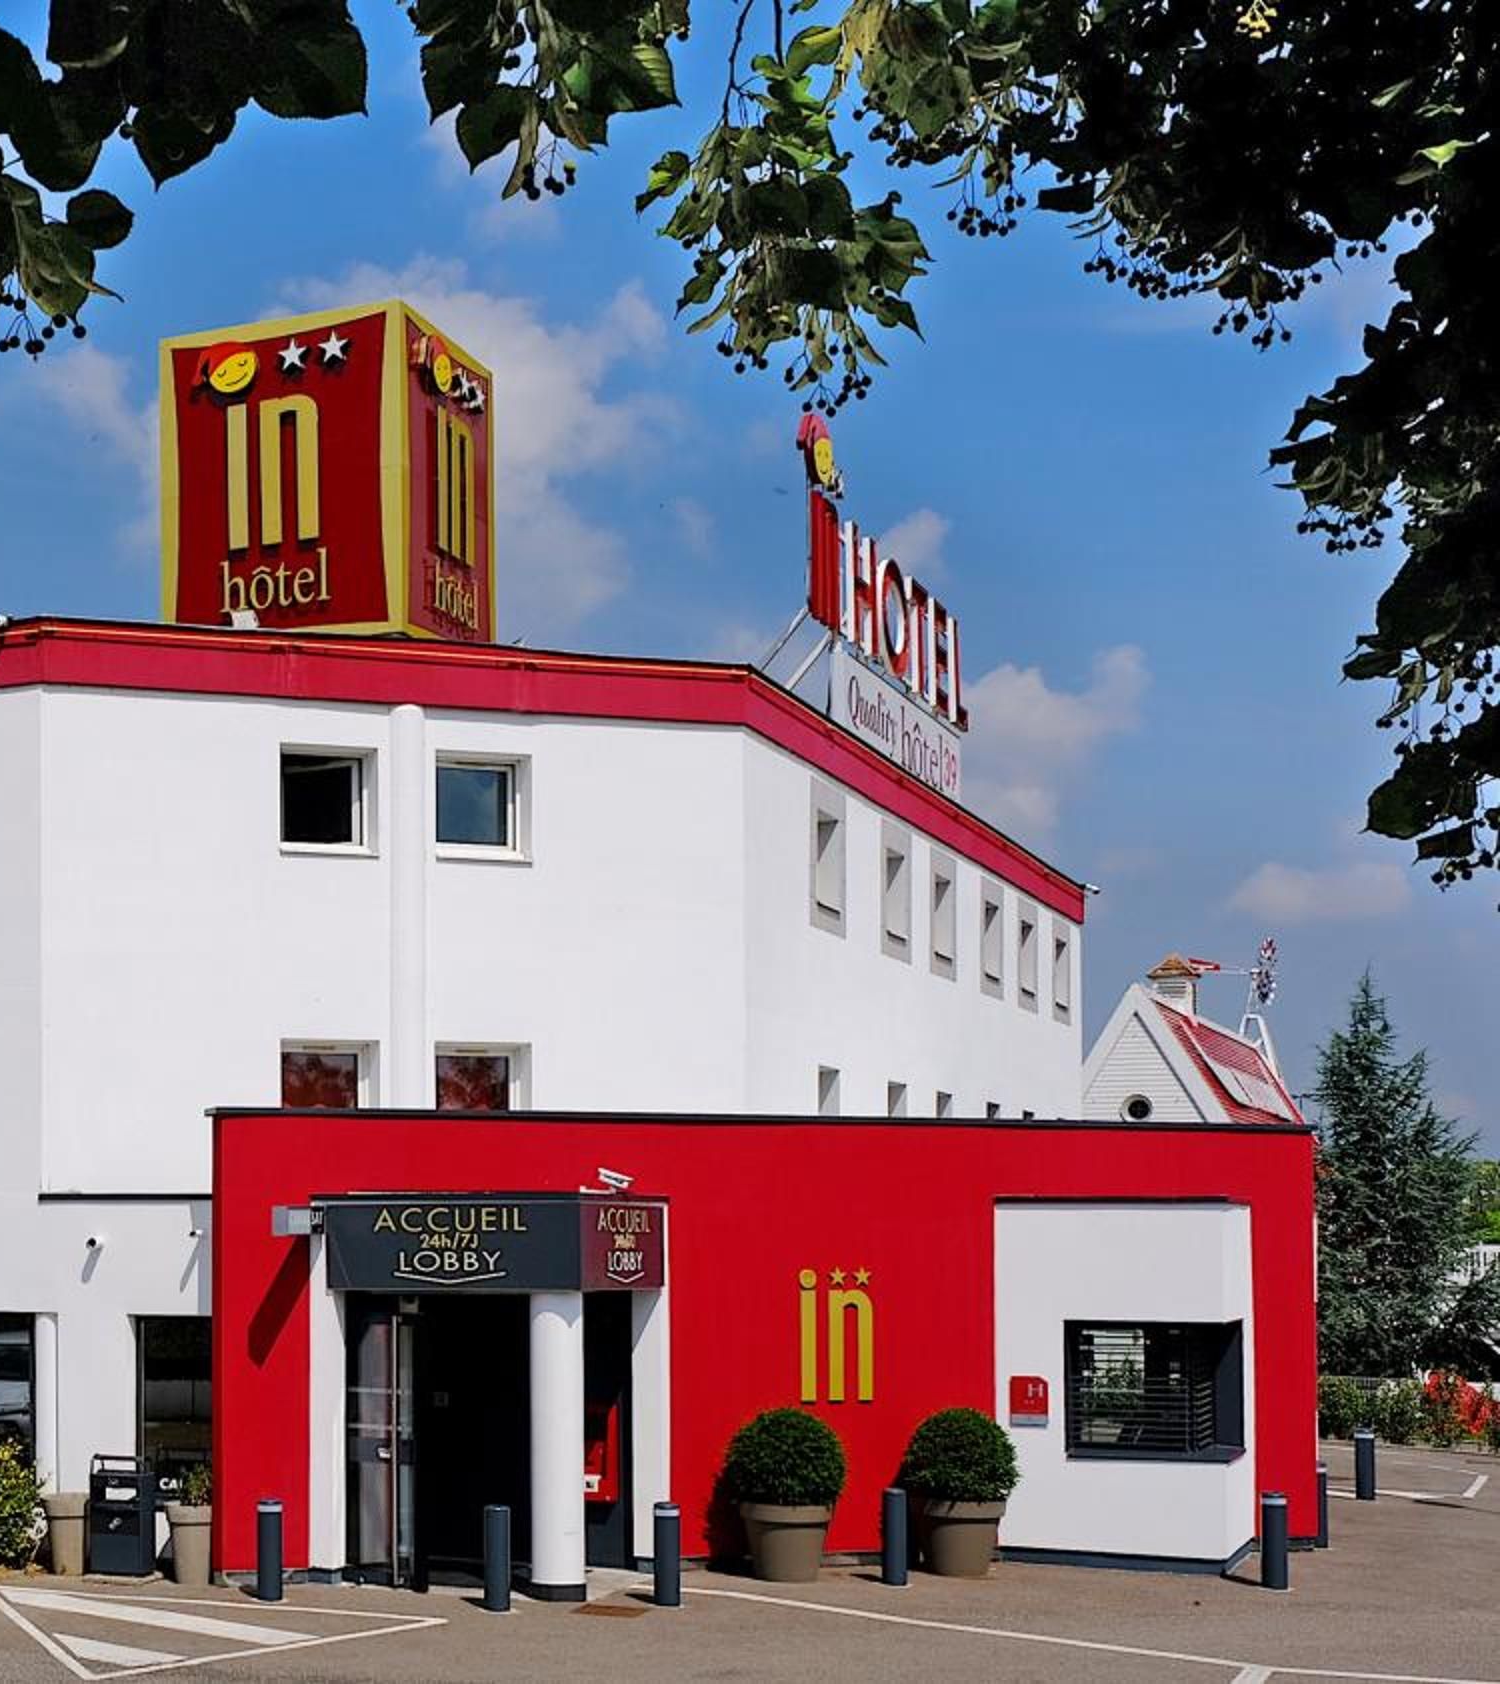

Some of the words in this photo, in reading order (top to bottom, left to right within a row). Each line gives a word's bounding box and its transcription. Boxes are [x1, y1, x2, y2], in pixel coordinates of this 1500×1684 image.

[220, 547, 332, 613] hôtel
[434, 557, 479, 632] hôtel
[844, 520, 969, 732] HOTEL
[847, 675, 899, 758] Quality
[900, 705, 944, 793] hôtel
[373, 1206, 528, 1234] ACCUEIL
[597, 1206, 651, 1234] ACCUEIL
[399, 1250, 501, 1272] LOBBY
[606, 1250, 644, 1272] LOBBY
[800, 1268, 874, 1403] in
[1027, 1383, 1044, 1398] H
